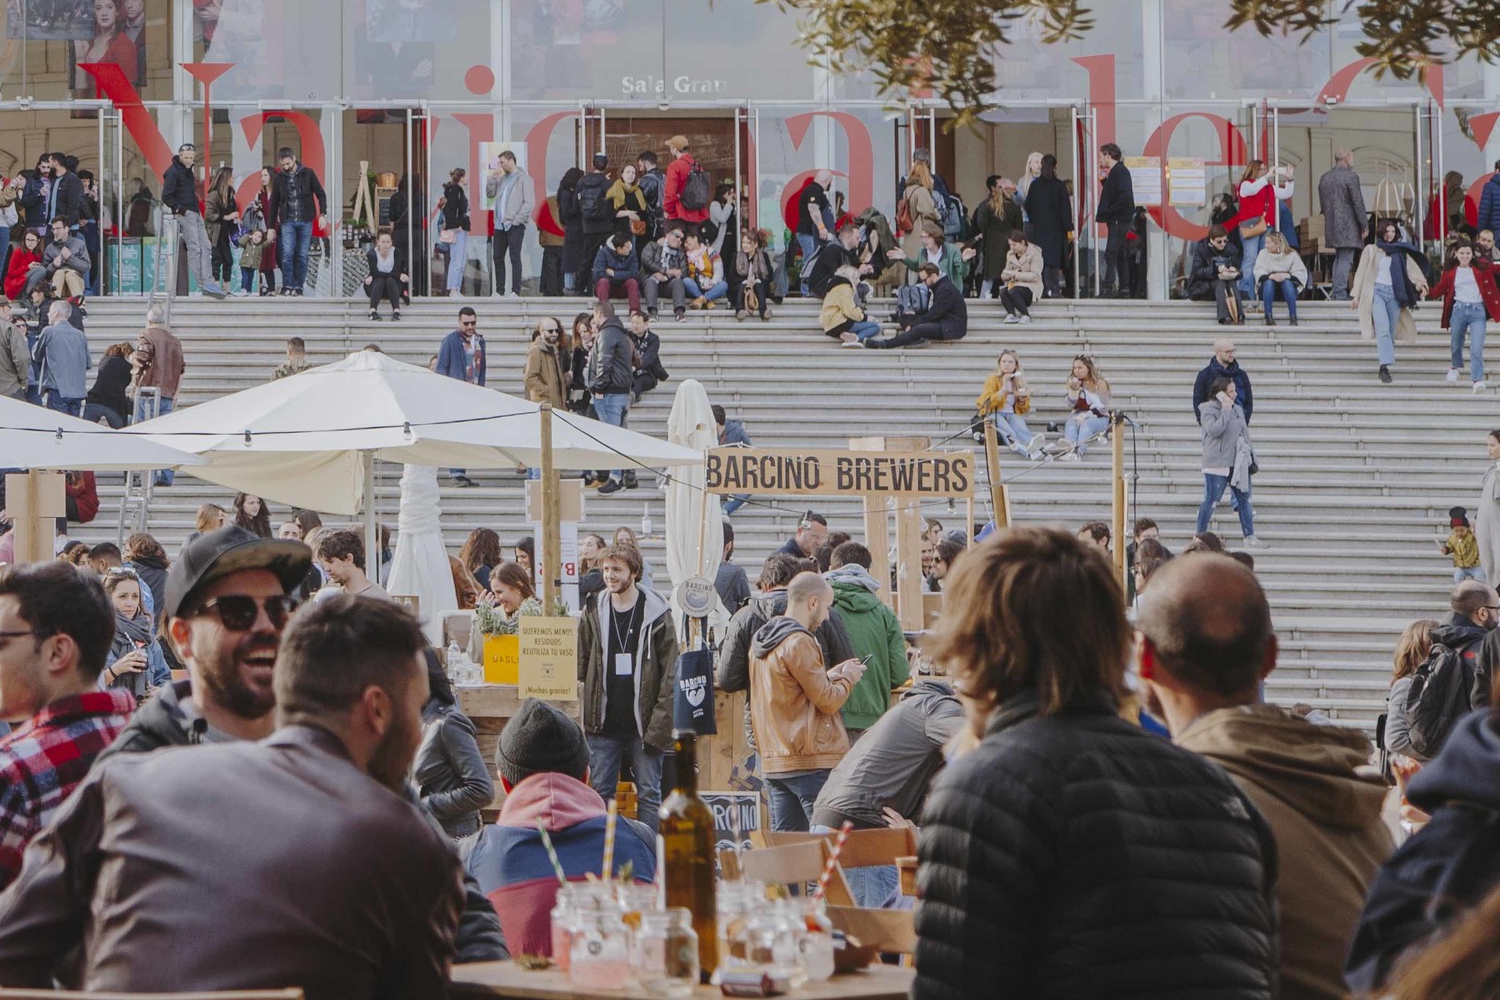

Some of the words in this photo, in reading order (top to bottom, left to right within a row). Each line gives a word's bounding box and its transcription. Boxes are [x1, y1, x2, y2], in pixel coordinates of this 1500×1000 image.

[621, 75, 665, 94] Sala
[707, 454, 820, 490] BARCINO
[837, 457, 968, 493] BREWERS
[685, 581, 714, 592] BARCINO
[522, 627, 553, 636] QUEREMOS
[554, 628, 574, 636] MENOS
[534, 638, 562, 646] RESIDUOS
[522, 648, 550, 656] REUTILIZA
[551, 648, 558, 656] TU
[559, 648, 574, 656] VASO
[679, 675, 707, 689] BARCINO
